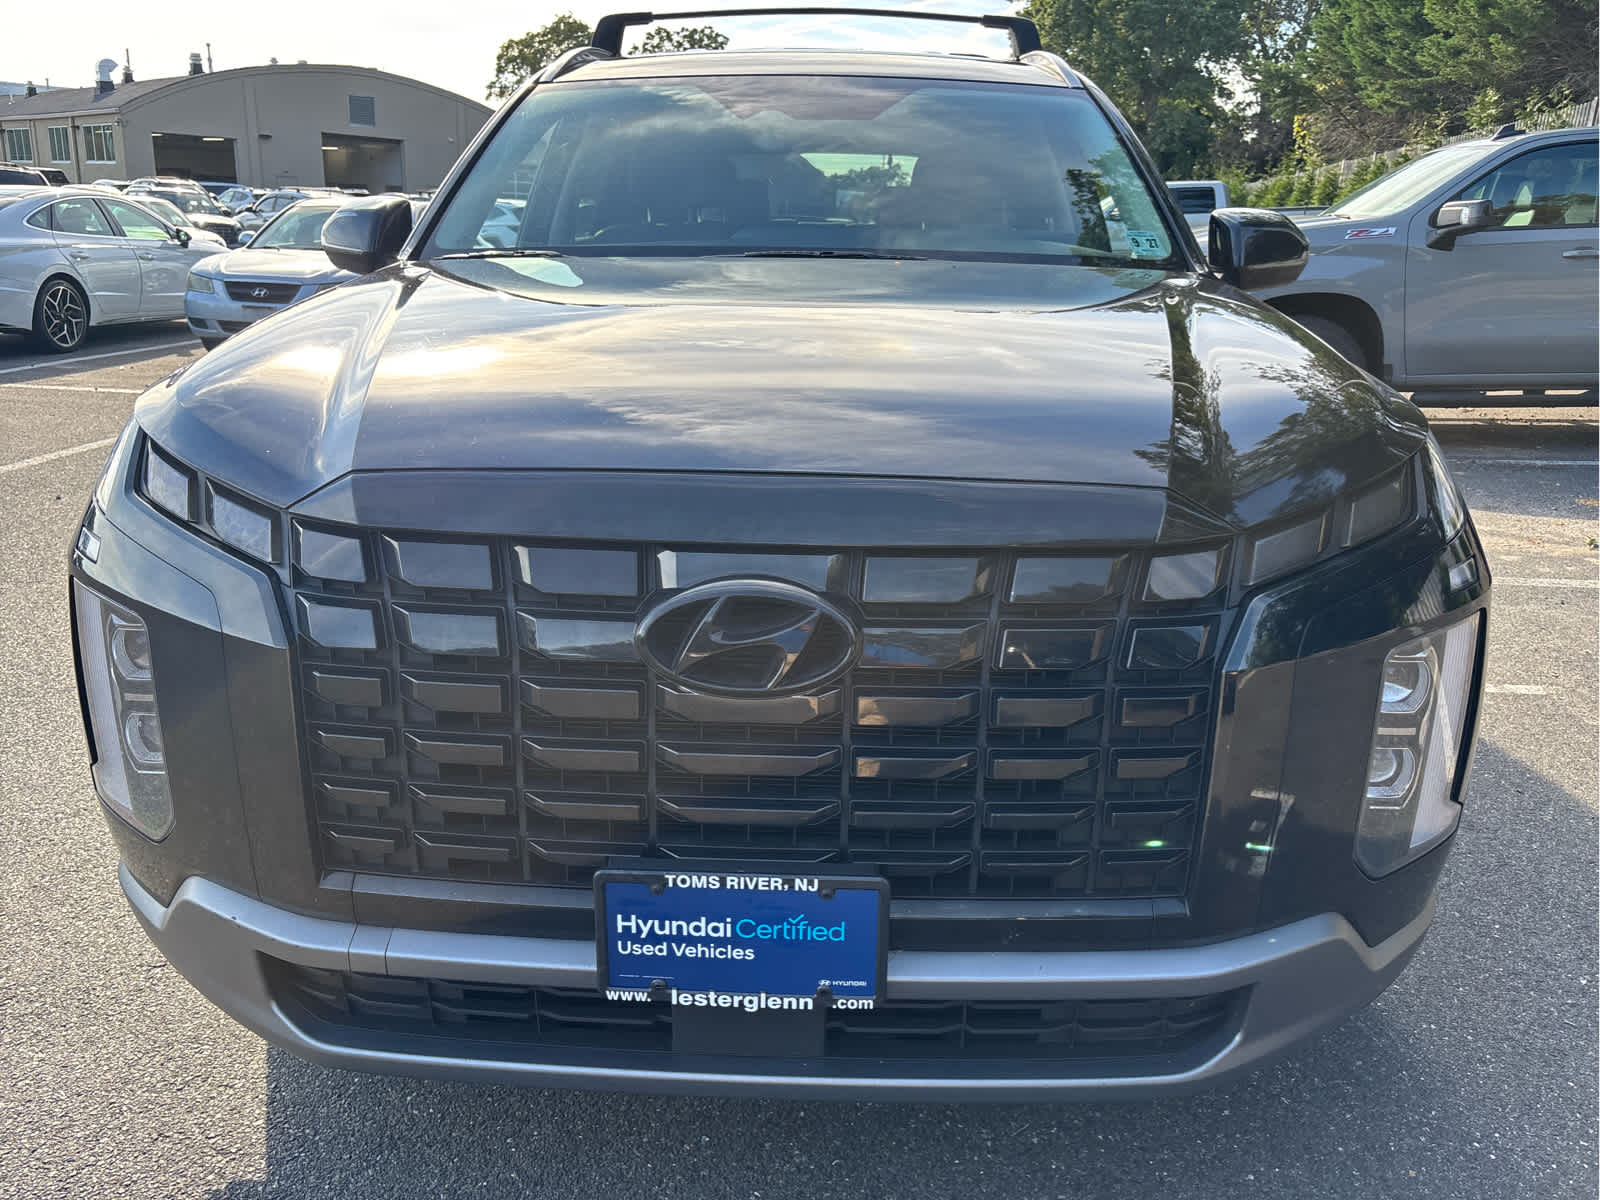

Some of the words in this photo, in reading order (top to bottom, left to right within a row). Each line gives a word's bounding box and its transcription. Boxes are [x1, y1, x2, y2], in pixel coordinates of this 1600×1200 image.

[1131, 237, 1140, 248] 9
[1145, 238, 1159, 249] 27
[664, 874, 721, 889] TOMS
[726, 876, 789, 891] RIVER,
[795, 878, 819, 892] NJ
[616, 914, 732, 938] Hyundai
[735, 914, 846, 942] Certified
[617, 940, 668, 956] Used
[671, 942, 756, 960] Vehicles
[605, 990, 652, 1002] www.
[671, 989, 814, 1012] lesterglenn
[832, 999, 874, 1010] .com
